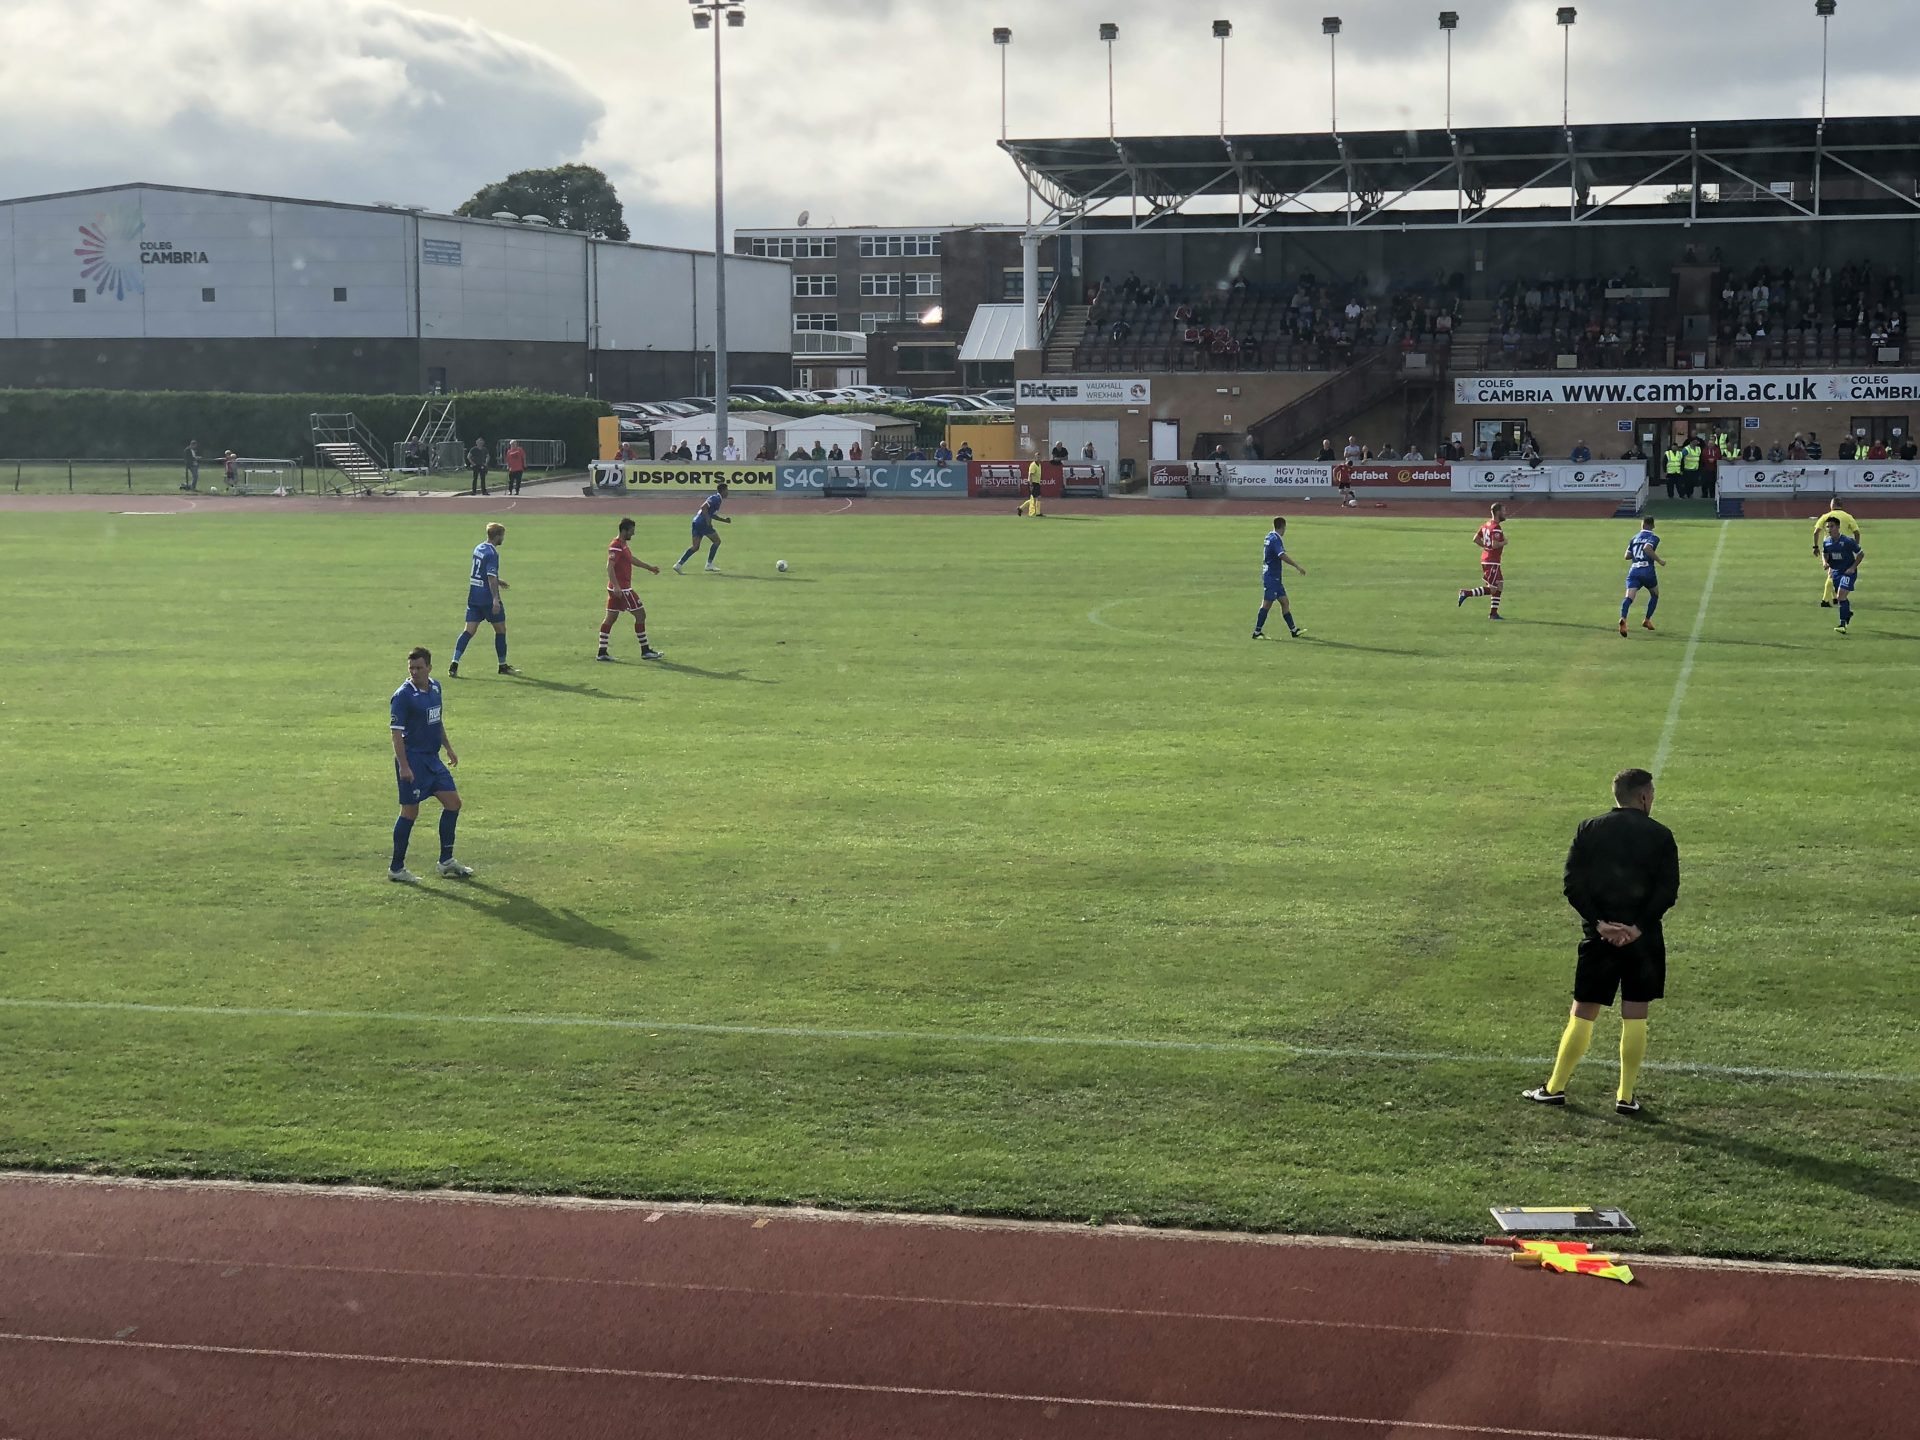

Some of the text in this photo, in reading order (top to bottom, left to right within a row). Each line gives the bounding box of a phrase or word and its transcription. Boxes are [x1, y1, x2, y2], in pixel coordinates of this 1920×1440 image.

[140, 242, 172, 250] COLEG
[140, 252, 209, 264] CAMBRIA
[1478, 380, 1514, 388] COLEG
[1851, 376, 1889, 384] COLEG
[1020, 383, 1078, 402] Dickens
[1478, 390, 1554, 402] CAMBRIA
[1562, 378, 1817, 402] www.cambria.ac.uk
[1850, 386, 1920, 400] CAMBRI
[628, 471, 773, 484] JDSPORTS.COM
[784, 468, 824, 488] S4C
[910, 468, 952, 488] S4C
[1296, 468, 1328, 476] Training
[1350, 471, 1388, 480] dafabet
[1412, 471, 1450, 480] dafabet
